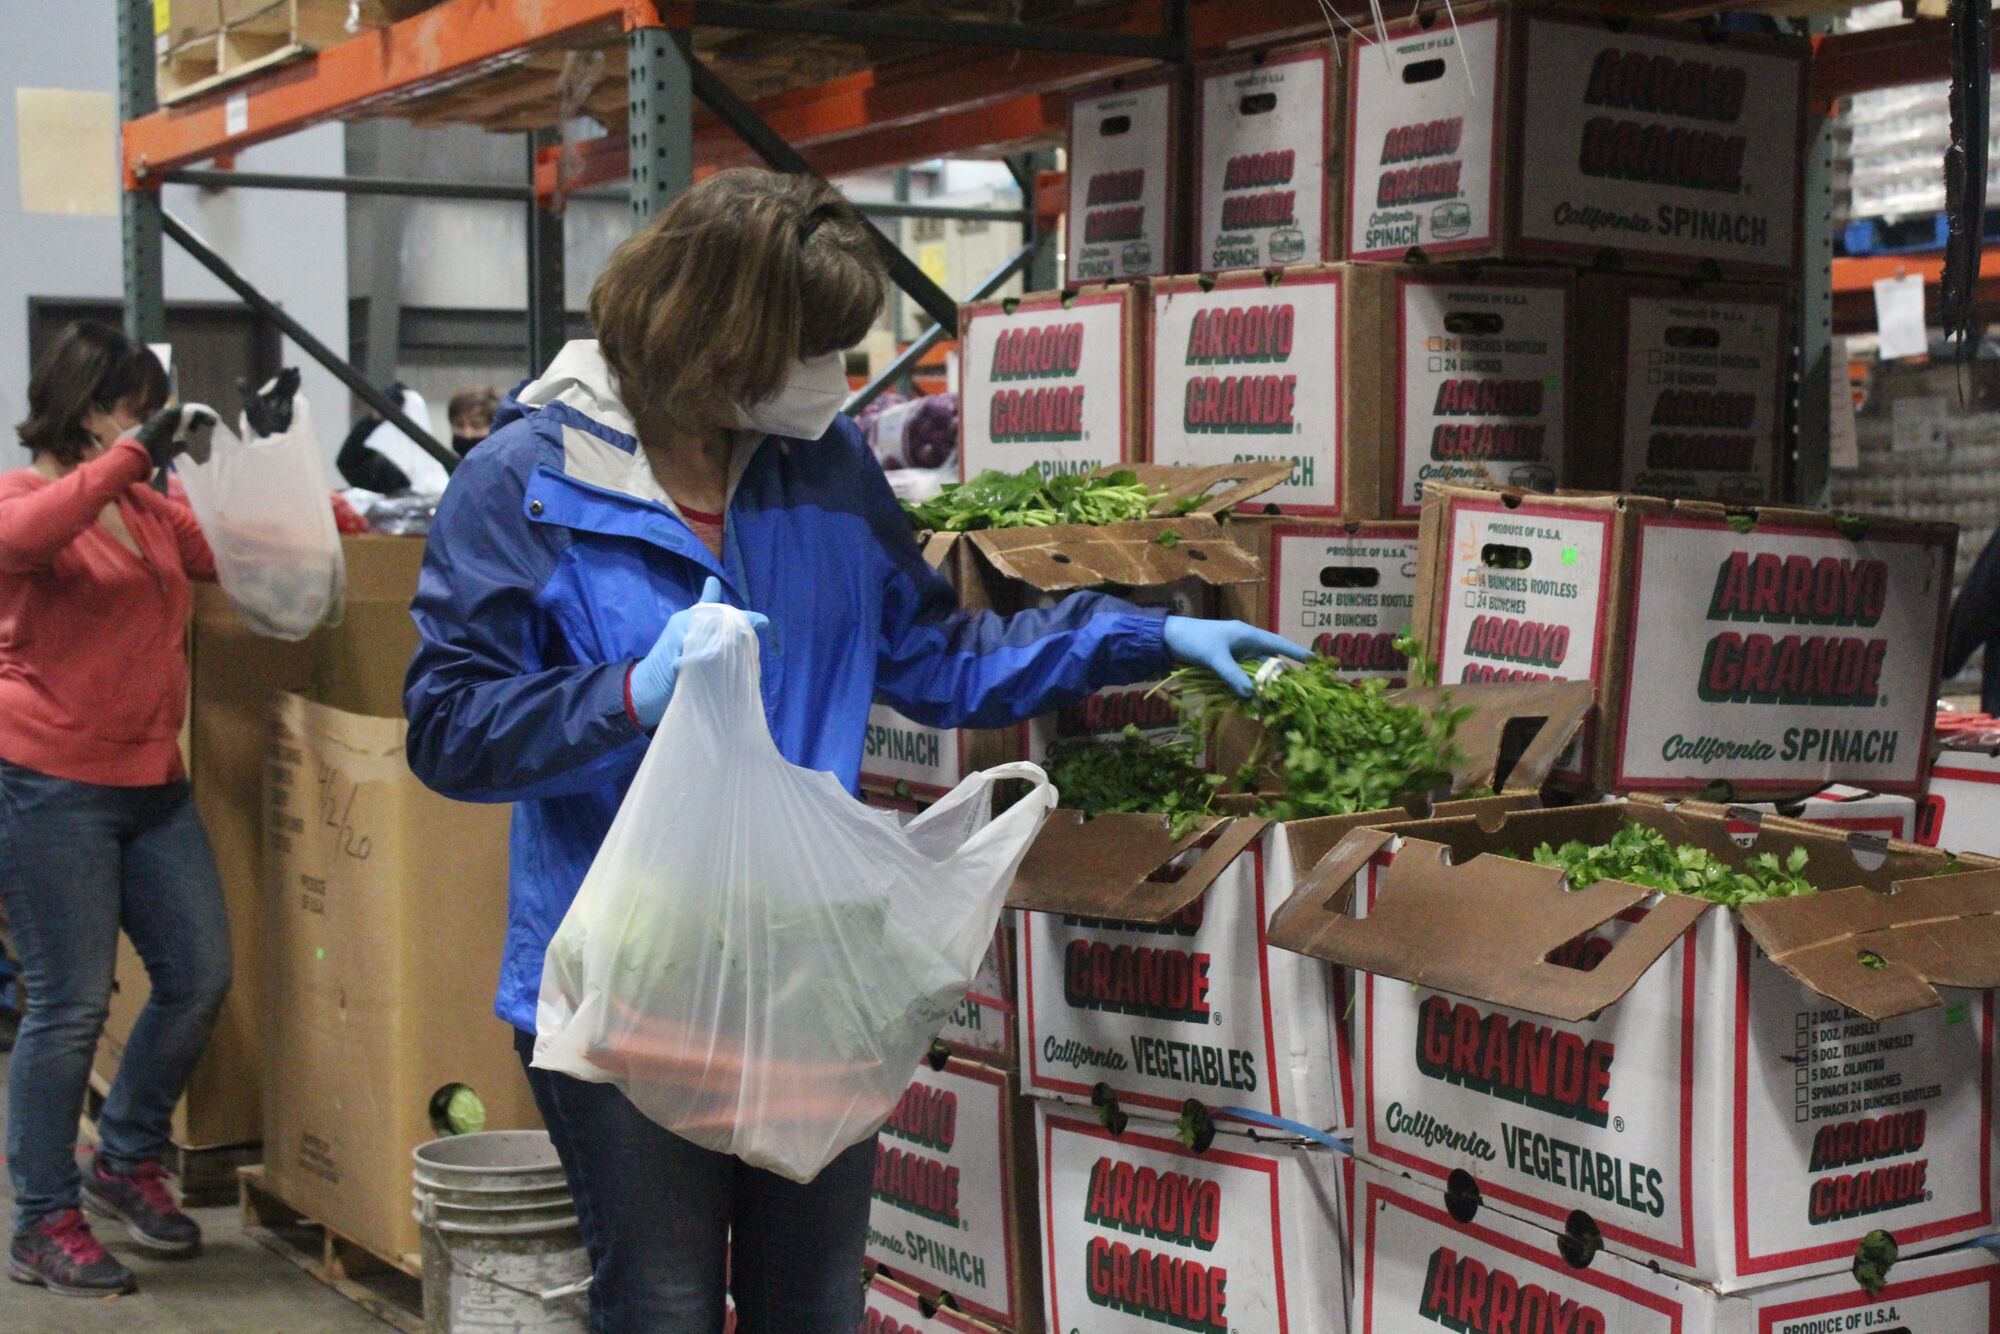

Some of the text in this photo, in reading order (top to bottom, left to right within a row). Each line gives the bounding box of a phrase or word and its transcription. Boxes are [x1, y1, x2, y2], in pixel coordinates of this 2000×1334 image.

[1366, 224, 1420, 249] SPINACH
[1553, 201, 1767, 246] California SPINACH
[1212, 248, 1260, 267] SPINACH
[990, 322, 1084, 382] ARROYO
[1186, 303, 1295, 366] ARROYO
[1444, 357, 1457, 371] 24
[989, 385, 1085, 443] GRANDE
[1184, 374, 1297, 434] GRANDE
[1419, 464, 1489, 482] California
[1327, 546, 1367, 557] PRODUCE
[1370, 549, 1381, 557] OF
[1488, 523, 1562, 541] PRODUCE OF U.S.A.
[1336, 593, 1378, 607] BUNCHES
[1381, 594, 1414, 608] ROOTLE
[1488, 575, 1527, 593] BUNCHES
[1531, 579, 1578, 599] ROOTLESS
[1488, 597, 1526, 614] BUNCHES
[1706, 551, 1888, 628] ARROYO
[1318, 613, 1378, 627] 24 BUNCHES
[1464, 615, 1569, 669] ARROYO
[1697, 631, 1887, 708] GRANDE
[866, 724, 939, 767] SPINACH
[1661, 728, 1898, 764] California SPINACH
[1064, 939, 1210, 1024] GRANDE
[1811, 1022, 1881, 1044] 5 DOZ. PARSLEY
[1812, 1013, 1819, 1025] 2
[1820, 1009, 1842, 1024] DOZ.
[1044, 1035, 1256, 1092] California VEGETABLES
[1416, 995, 1616, 1129] GRANDE
[1811, 1034, 1914, 1062] 5 DOZ. ITALIAN PARSLEY
[1811, 1058, 1885, 1081] 5 DOZ. CILANTRO
[1811, 1073, 1902, 1100] SPINACH 24 BUNCHES
[1811, 1084, 1942, 1119] SPINACH 24 BUNCHES ROOTLESS
[1386, 1101, 1665, 1218] California VEGETABLES
[1808, 1108, 1927, 1173] ARROYO
[871, 1141, 960, 1229] RANDE
[1084, 1156, 1221, 1252] ARROYO
[1808, 1159, 1928, 1226] GRANDE
[905, 1229, 986, 1288] SPINACH
[1086, 1236, 1228, 1334] GRANDE
[1845, 1312, 1861, 1329] OF
[1864, 1306, 1900, 1327] U.S.A.
